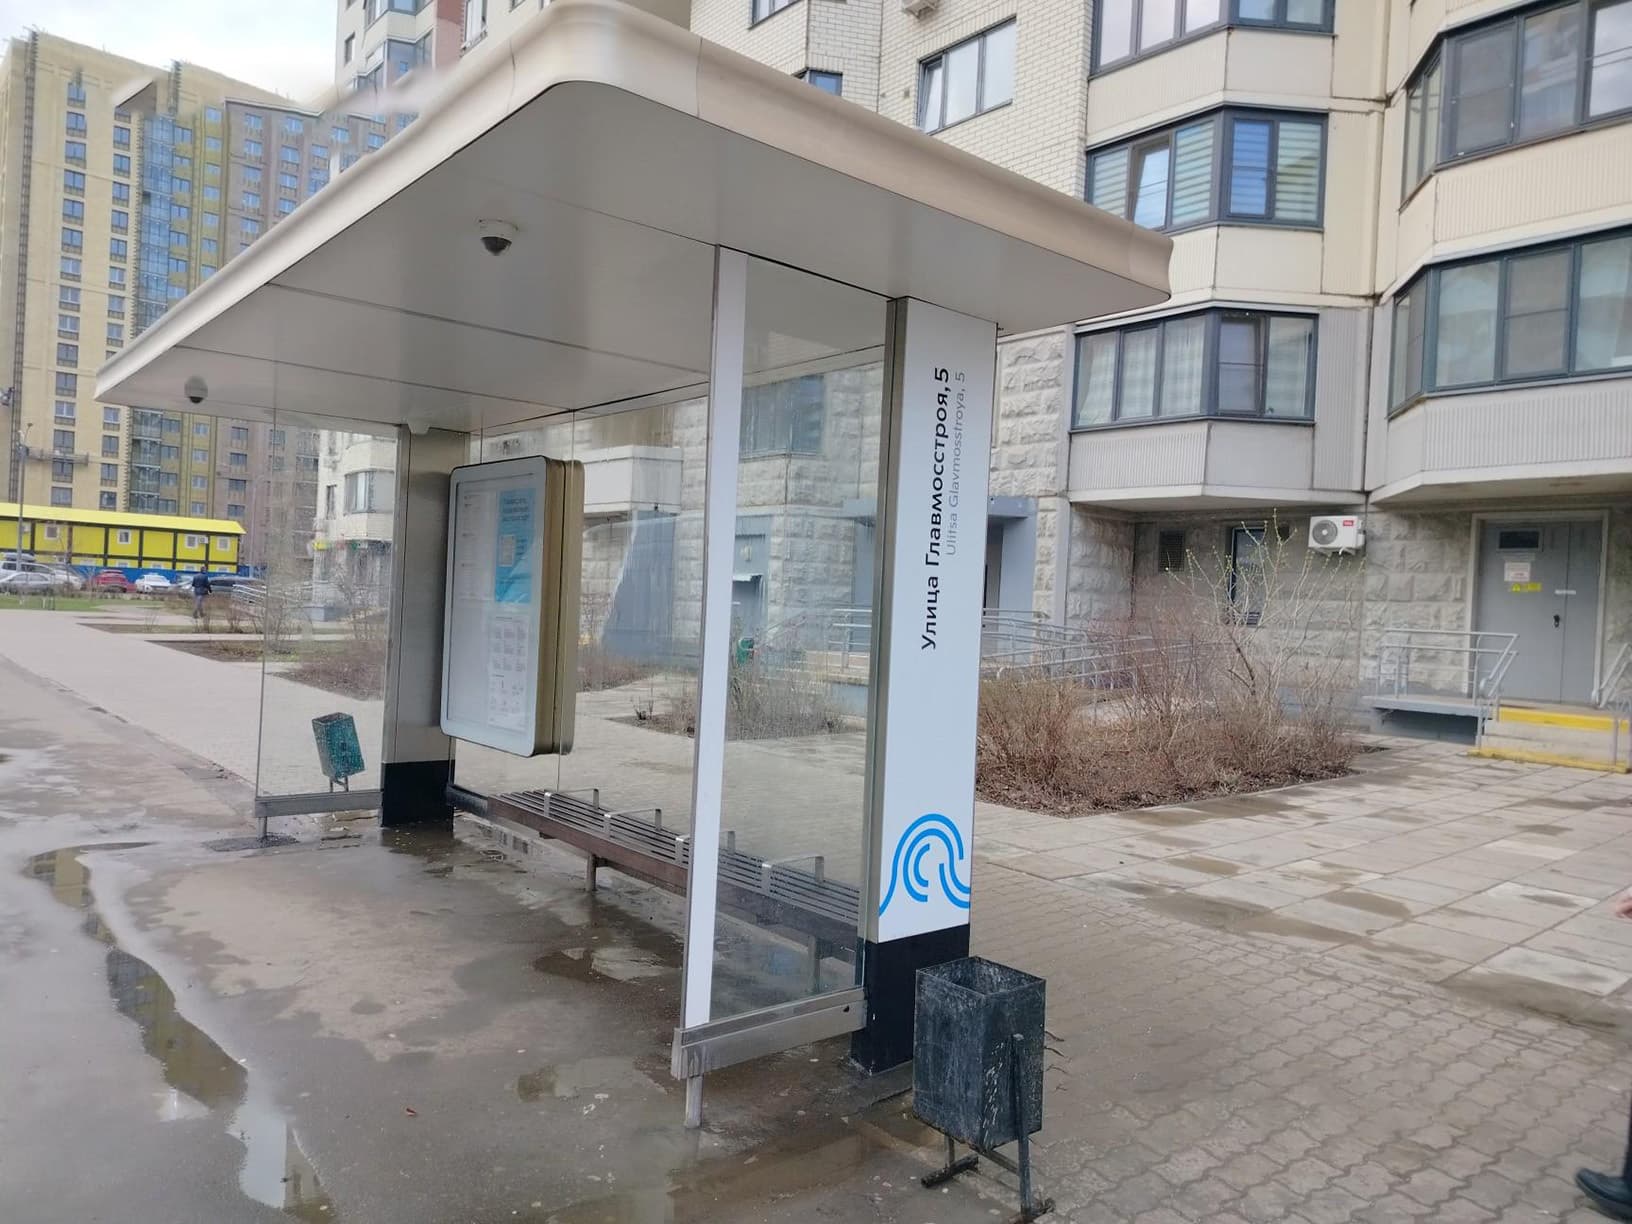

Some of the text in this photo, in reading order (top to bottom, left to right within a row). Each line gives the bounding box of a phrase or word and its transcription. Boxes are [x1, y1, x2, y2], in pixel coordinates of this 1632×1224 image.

[946, 371, 966, 556] Ulitsa Glavmosstroya, 5
[921, 575, 940, 651] Улица
